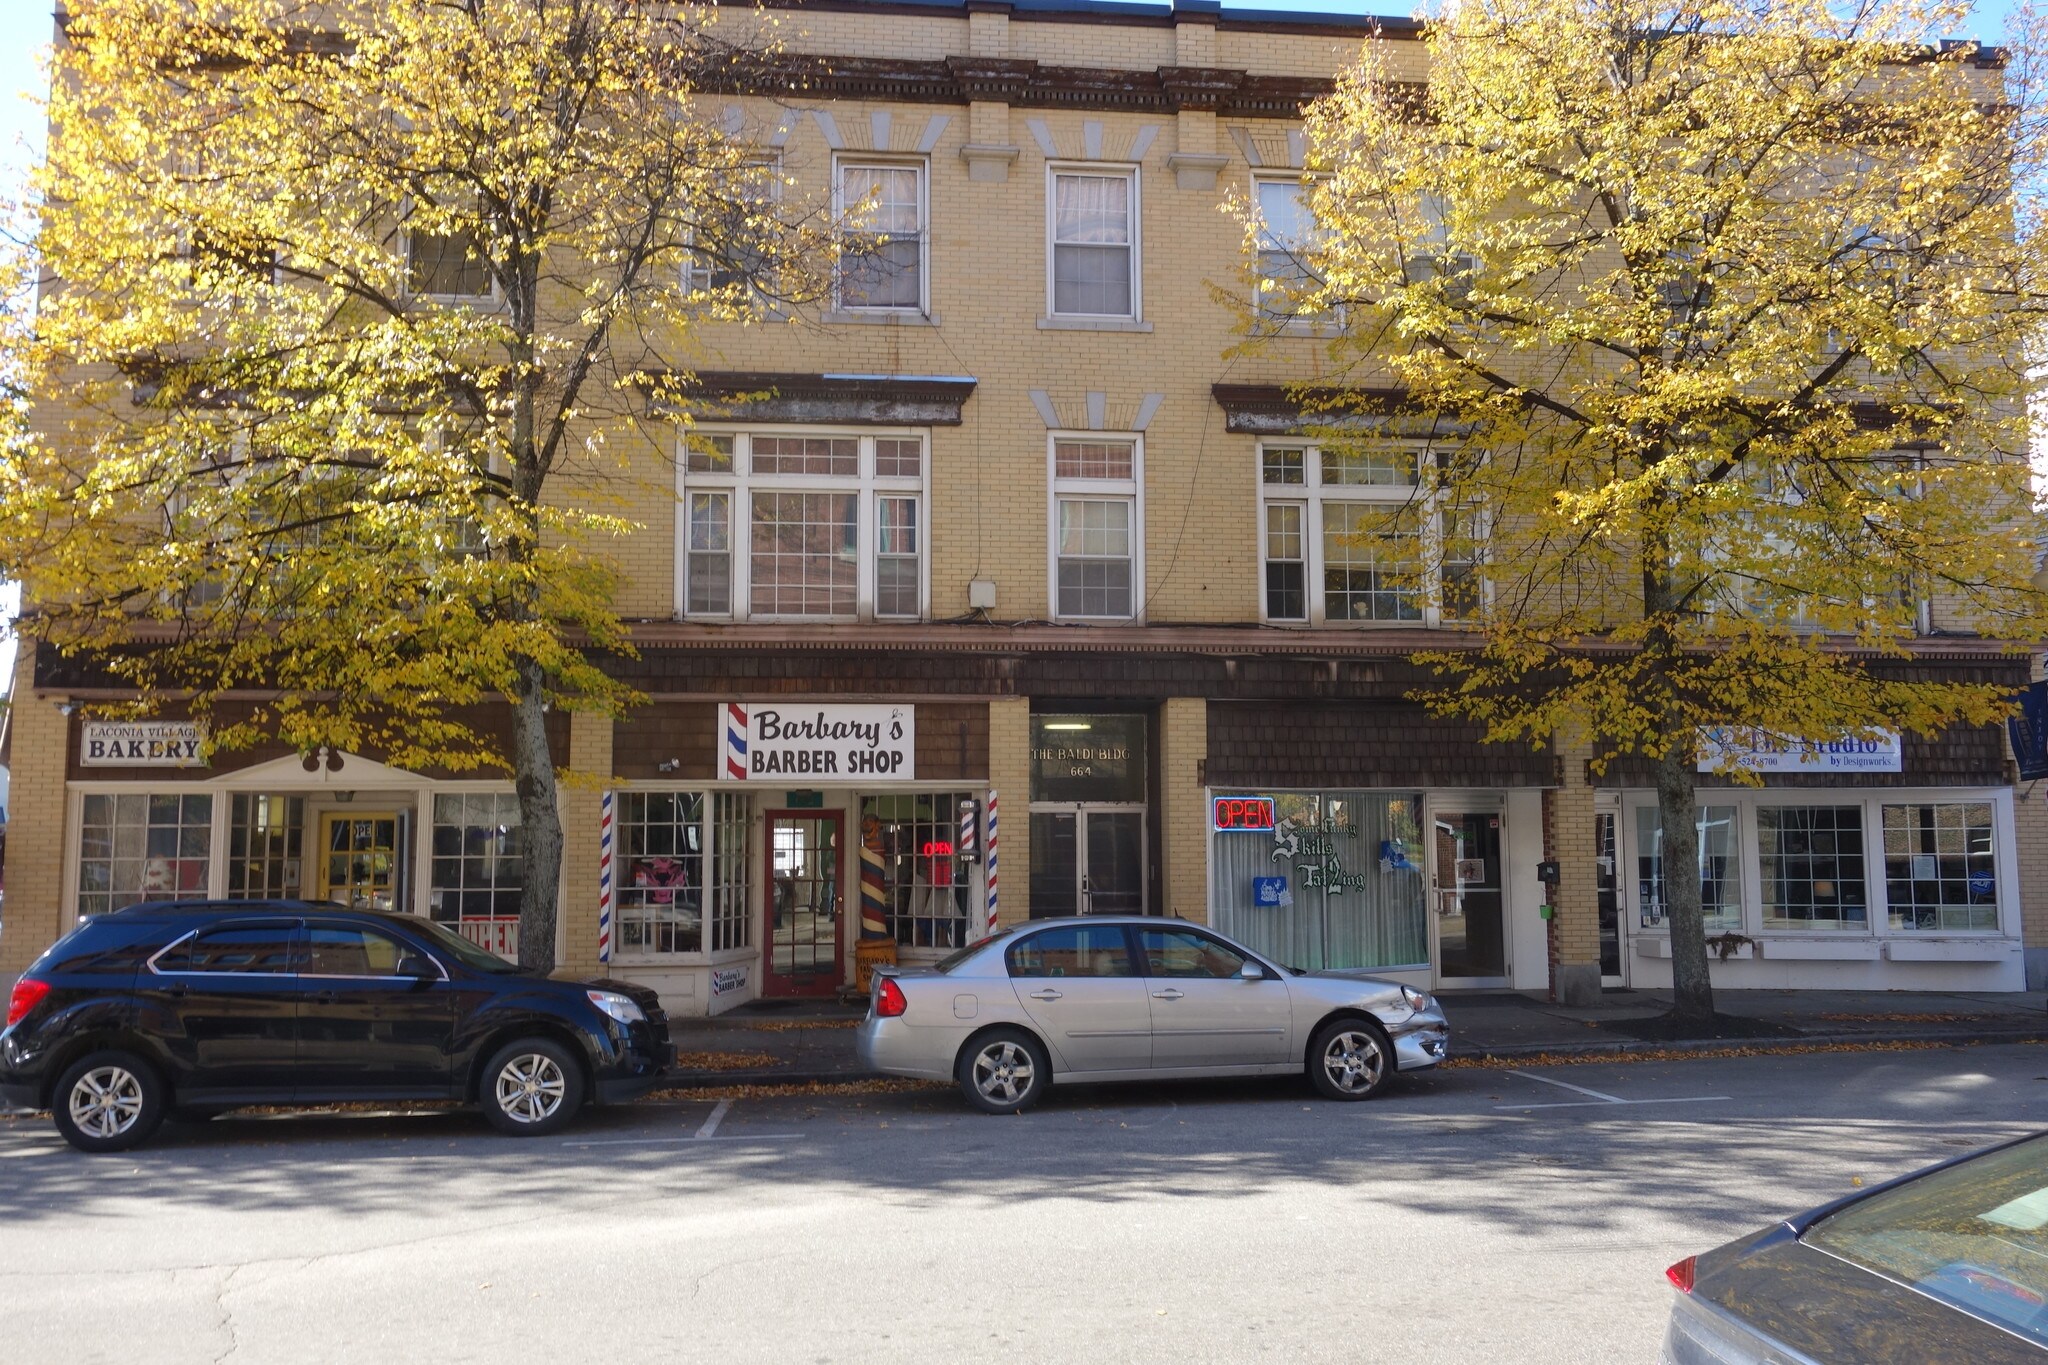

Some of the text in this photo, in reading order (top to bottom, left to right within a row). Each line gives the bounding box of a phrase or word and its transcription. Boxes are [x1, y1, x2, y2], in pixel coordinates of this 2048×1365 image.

[90, 727, 144, 737] LACONIA
[753, 709, 904, 749] Barbary's
[89, 740, 200, 758] BAKERY
[1031, 748, 1130, 760] THE BALDI BLDG
[752, 750, 904, 773] BARBER SHOP
[1830, 756, 1842, 767] by
[1070, 766, 1091, 776] 664
[1216, 800, 1273, 828] OPEN
[923, 841, 953, 857] OPEN
[462, 919, 519, 955] OPEN
